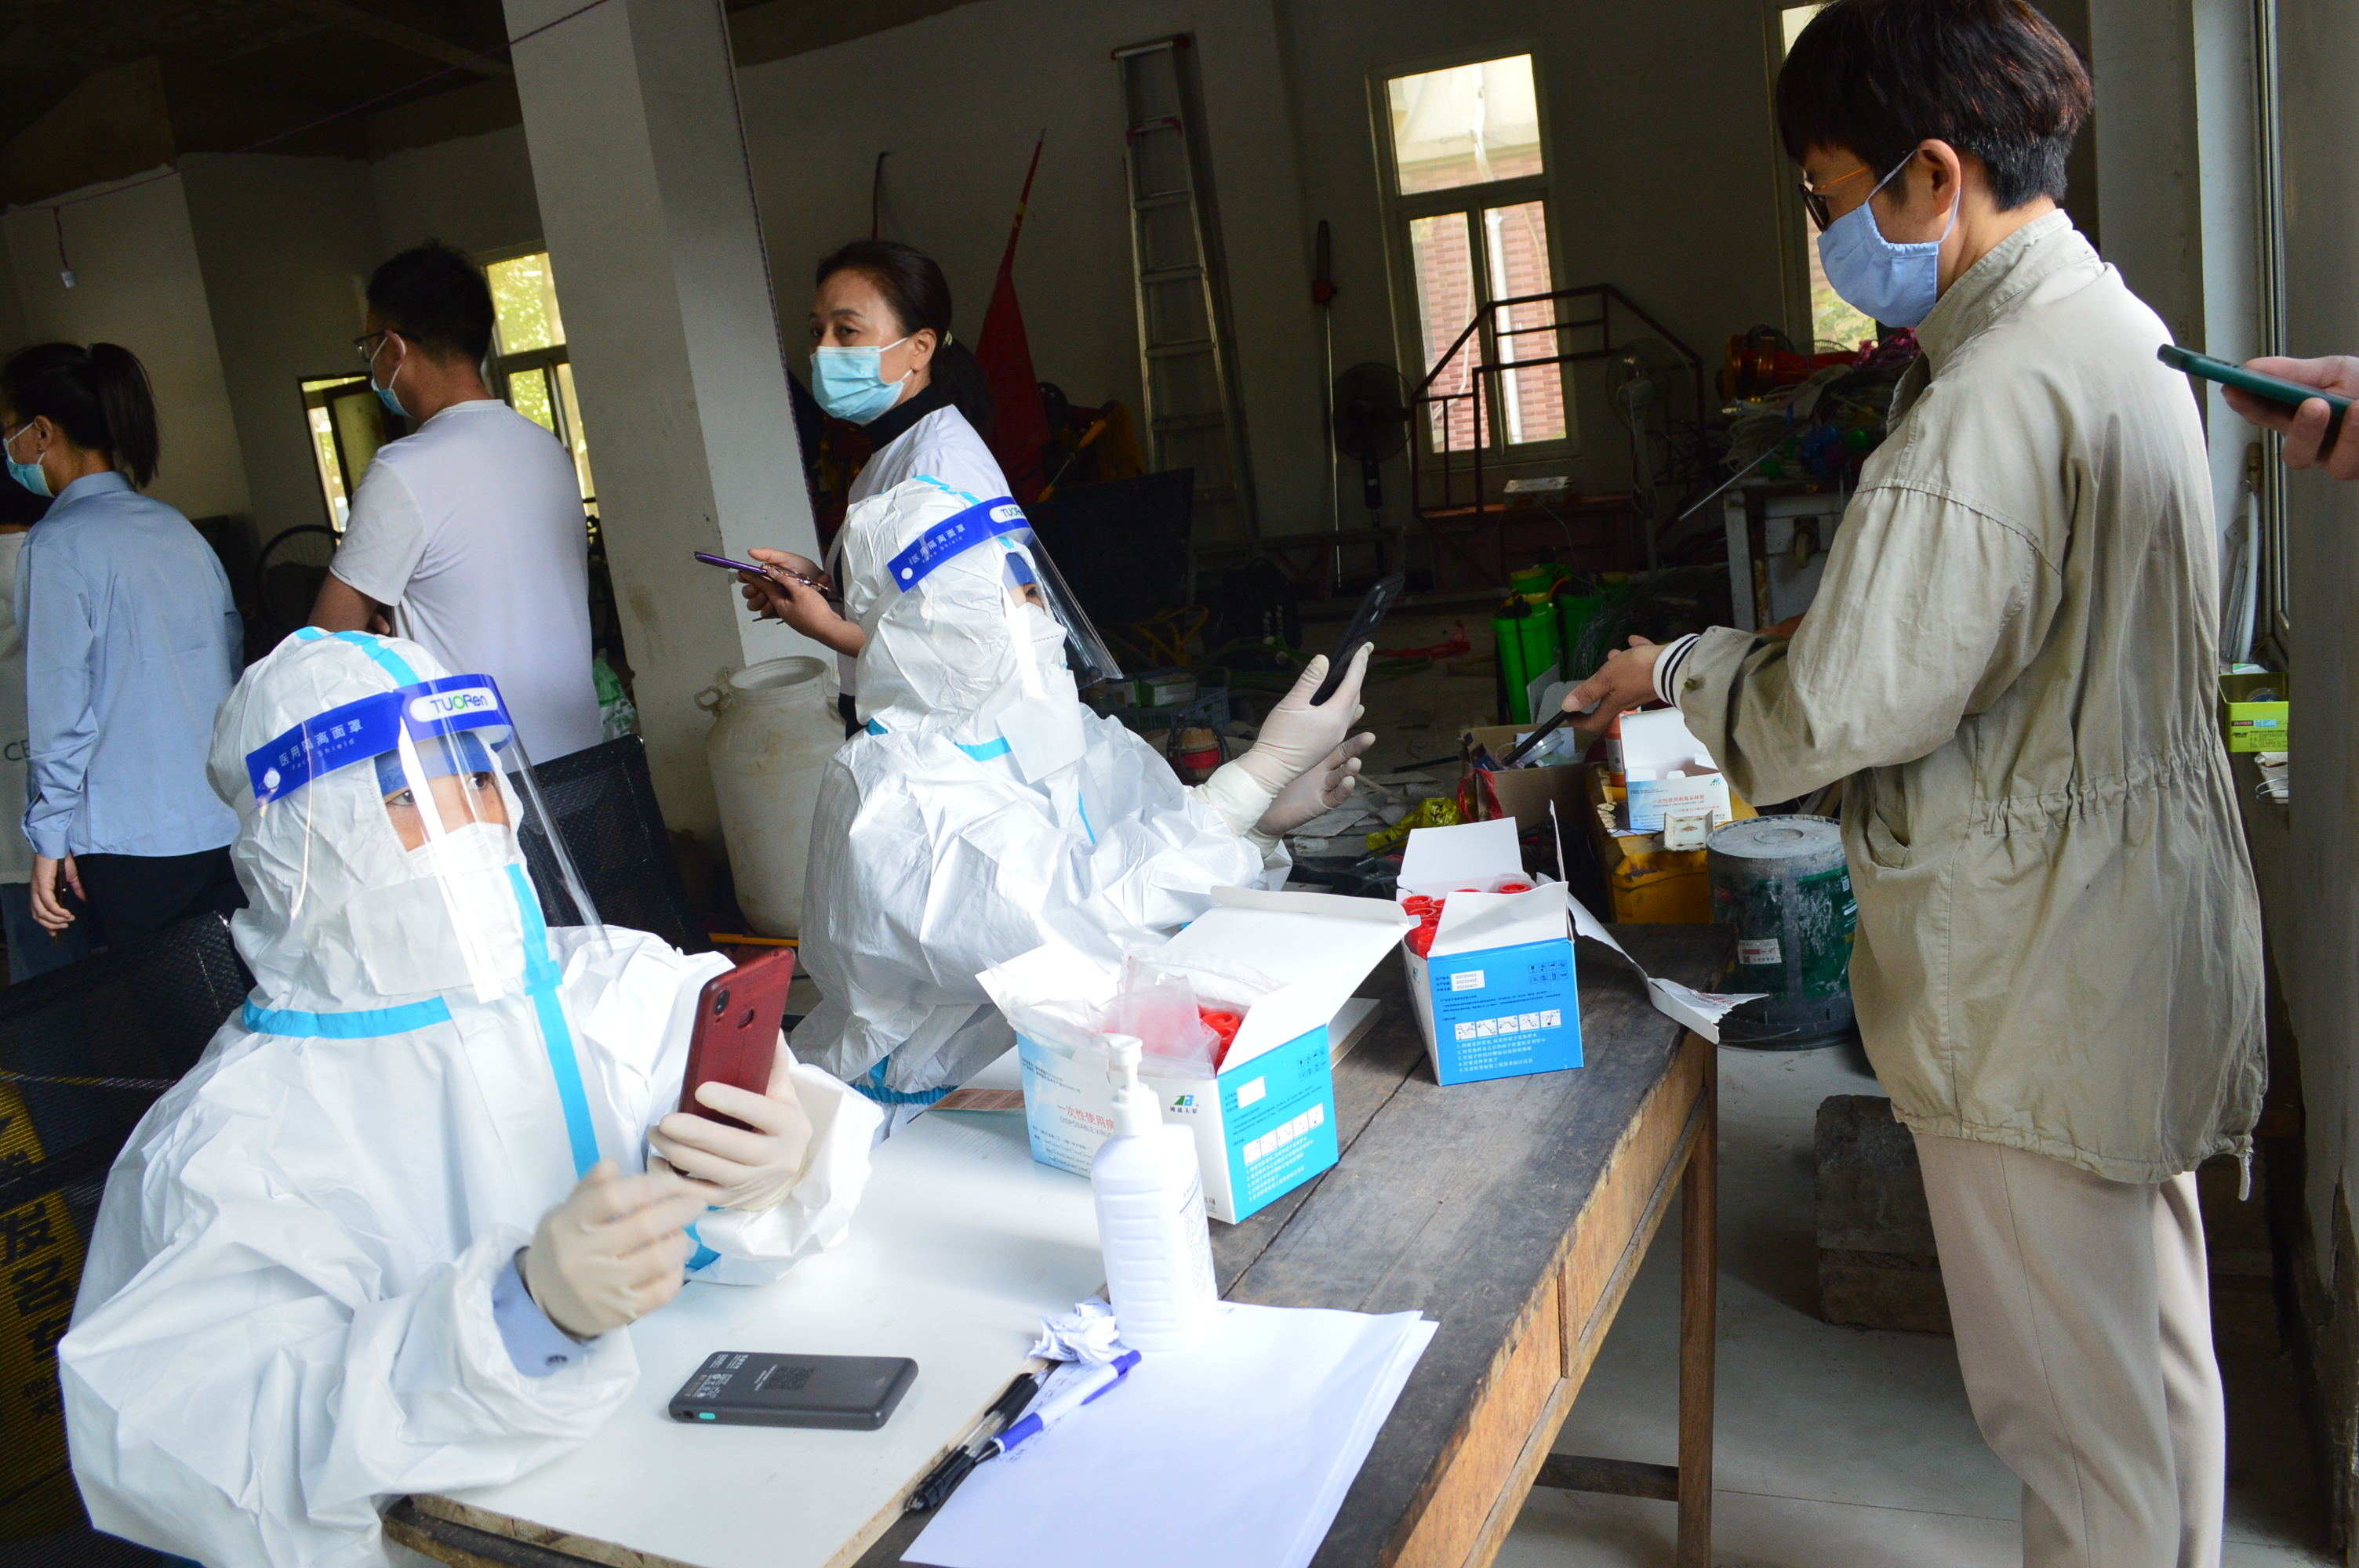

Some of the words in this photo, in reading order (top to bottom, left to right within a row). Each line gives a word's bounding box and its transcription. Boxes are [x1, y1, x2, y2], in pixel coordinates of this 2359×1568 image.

[911, 523, 966, 564] 医用隔离面罩
[429, 693, 489, 713] TUORen
[278, 718, 364, 767] 医用隔离面罩
[317, 738, 355, 757] Shield
[1060, 1116, 1095, 1134] DISPOSABLE
